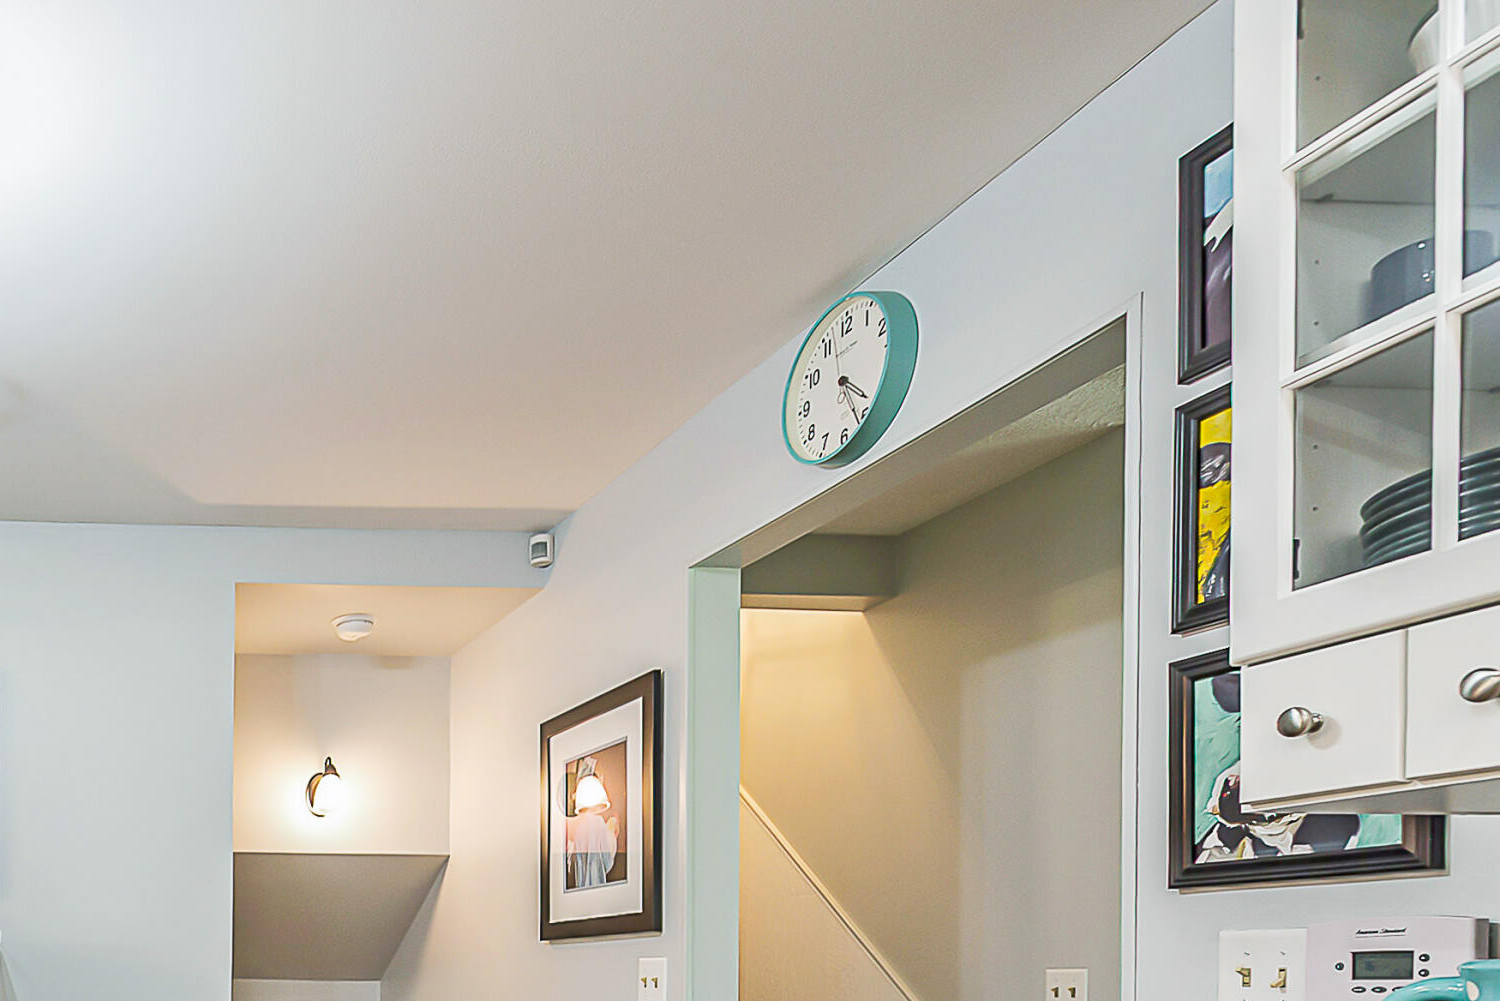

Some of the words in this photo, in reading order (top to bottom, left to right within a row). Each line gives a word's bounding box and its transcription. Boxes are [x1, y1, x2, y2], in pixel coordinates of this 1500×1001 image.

[840, 315, 853, 338] 12
[864, 309, 869, 327] 1
[877, 317, 886, 338] 2
[823, 339, 832, 359] 11
[809, 368, 821, 390] 10
[802, 400, 811, 418] 9
[807, 423, 816, 441] 8
[821, 432, 830, 451] 7
[840, 428, 849, 445] 6
